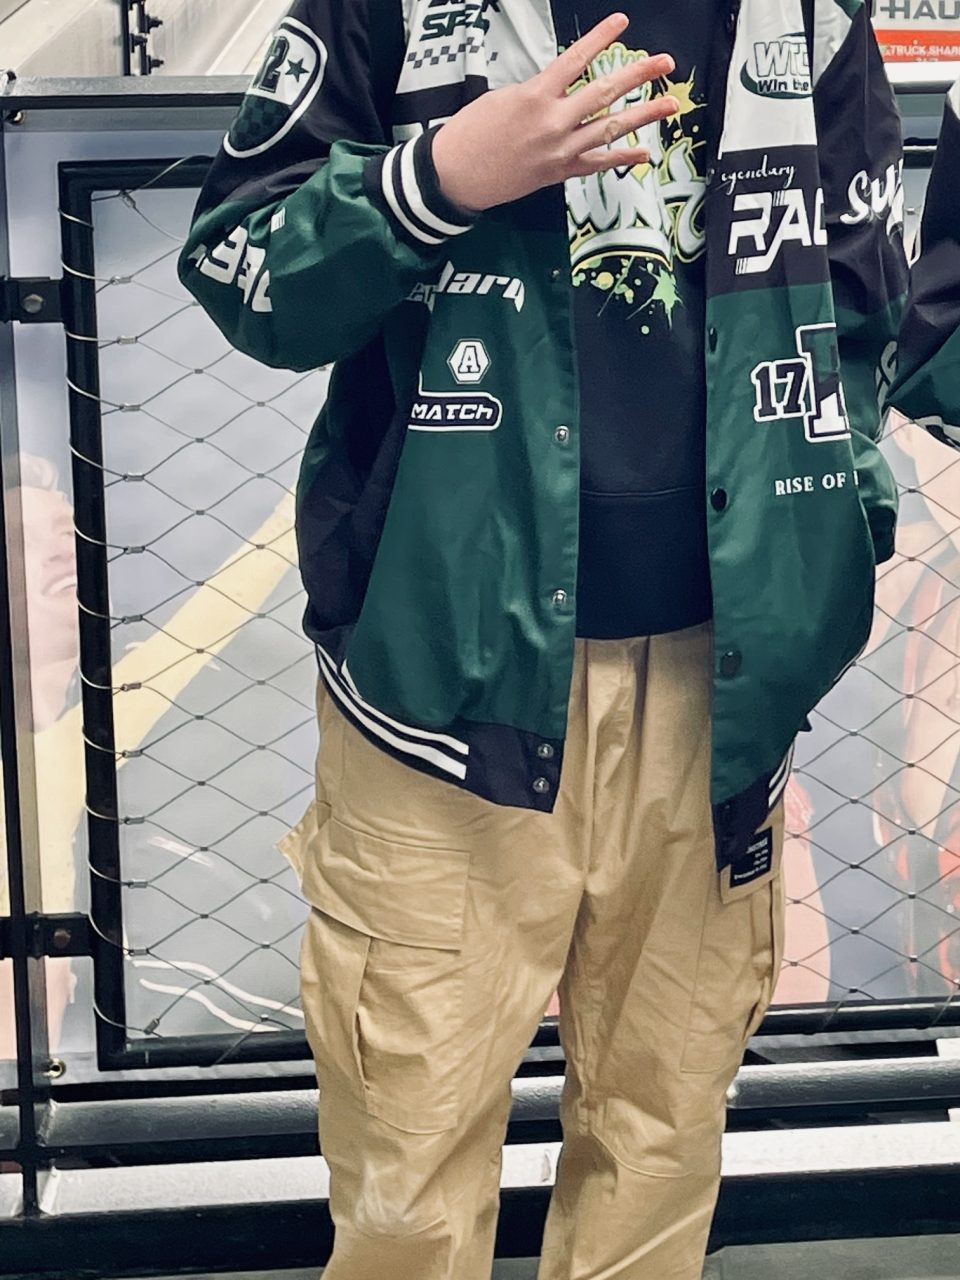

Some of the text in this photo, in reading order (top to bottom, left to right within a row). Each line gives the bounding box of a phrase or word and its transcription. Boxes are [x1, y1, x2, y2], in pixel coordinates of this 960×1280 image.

[889, 44, 926, 57] TRUCK
[457, 345, 482, 374] A
[775, 476, 814, 496] RISE
[822, 472, 847, 490] OF
